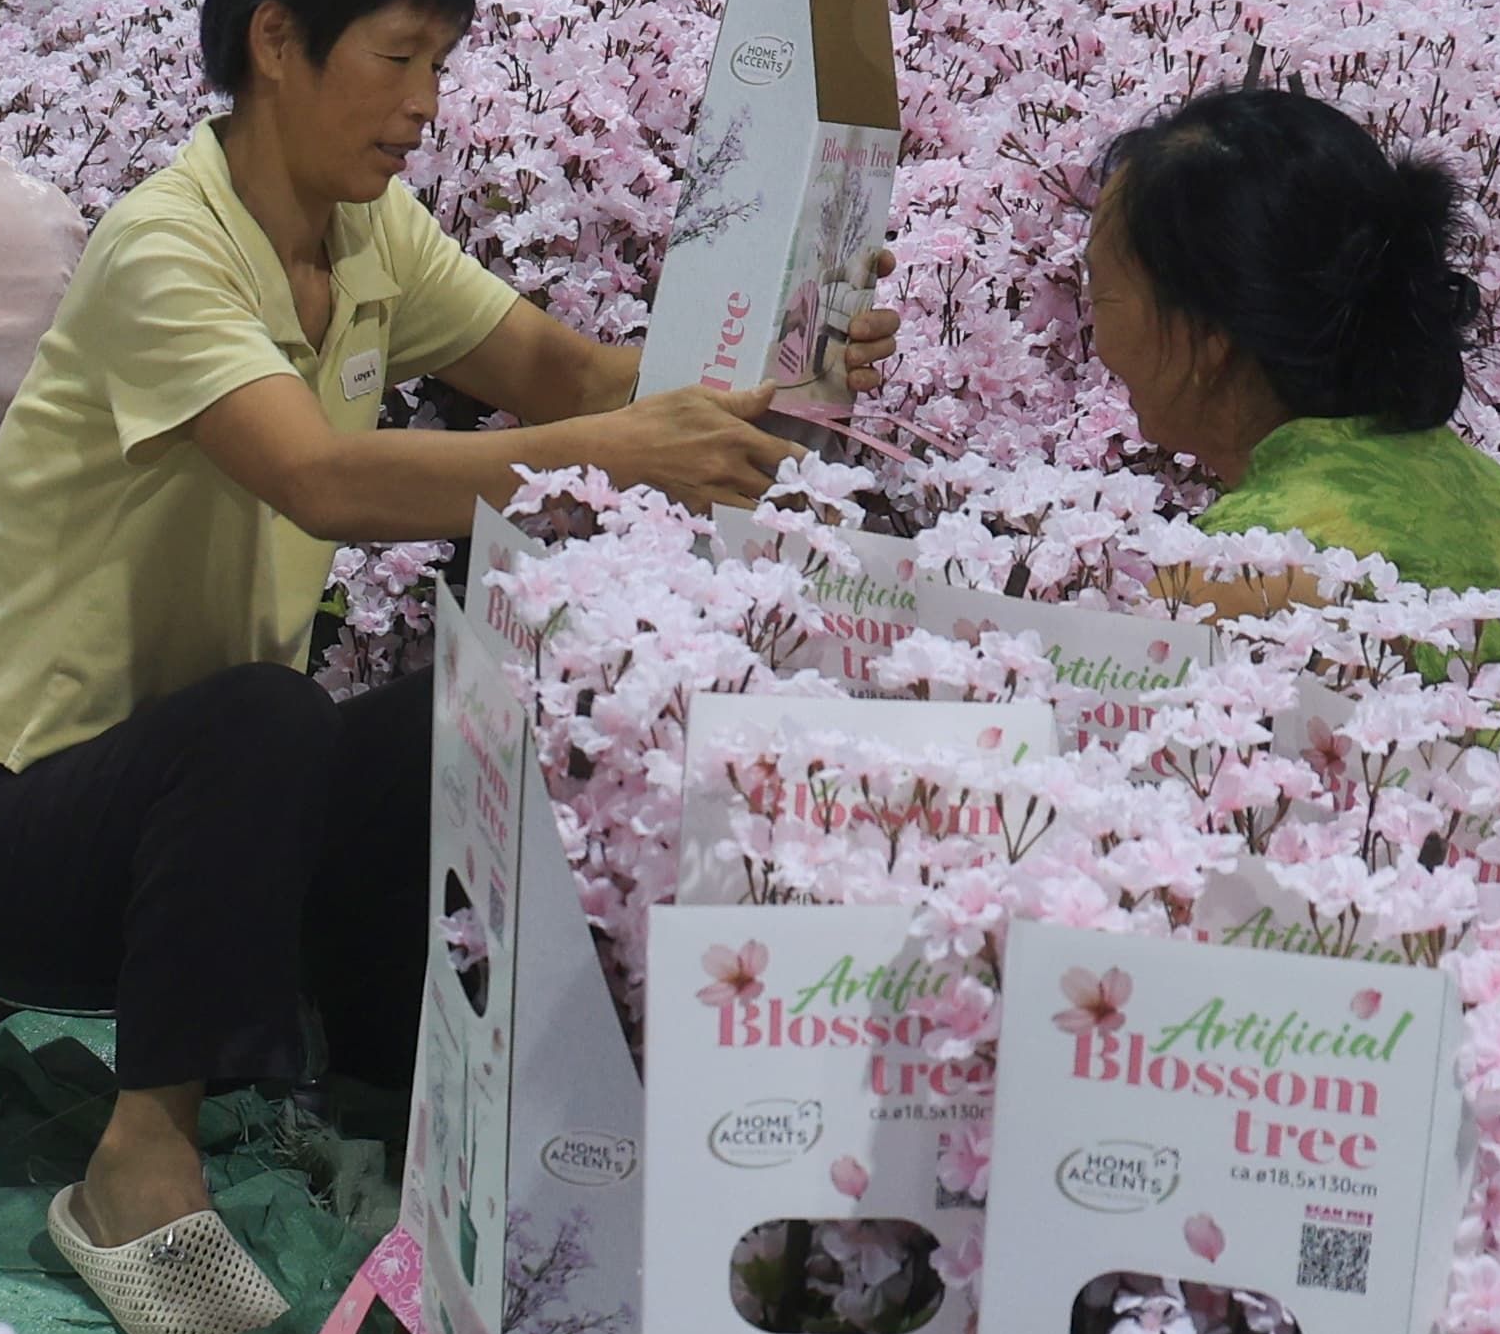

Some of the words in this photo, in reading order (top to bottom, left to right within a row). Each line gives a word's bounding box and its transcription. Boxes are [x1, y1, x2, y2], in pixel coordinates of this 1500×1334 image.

[736, 54, 783, 74] ACCENTS
[747, 45, 778, 60] HOME
[869, 143, 894, 168] Tree
[800, 565, 918, 615] Artificia
[717, 998, 935, 1048] Blosso
[1149, 997, 1414, 1067] Artificial
[1071, 1030, 1380, 1117] Blossom
[735, 1115, 793, 1131] HOME
[718, 1129, 808, 1145] ACCENTS
[1234, 1110, 1378, 1170] tree
[549, 1149, 624, 1173] ACCENTS
[563, 1140, 611, 1160] HOME
[1086, 1154, 1147, 1177] HOME
[1068, 1168, 1163, 1196] ACCENTS
[1304, 1204, 1343, 1220] SCAN
